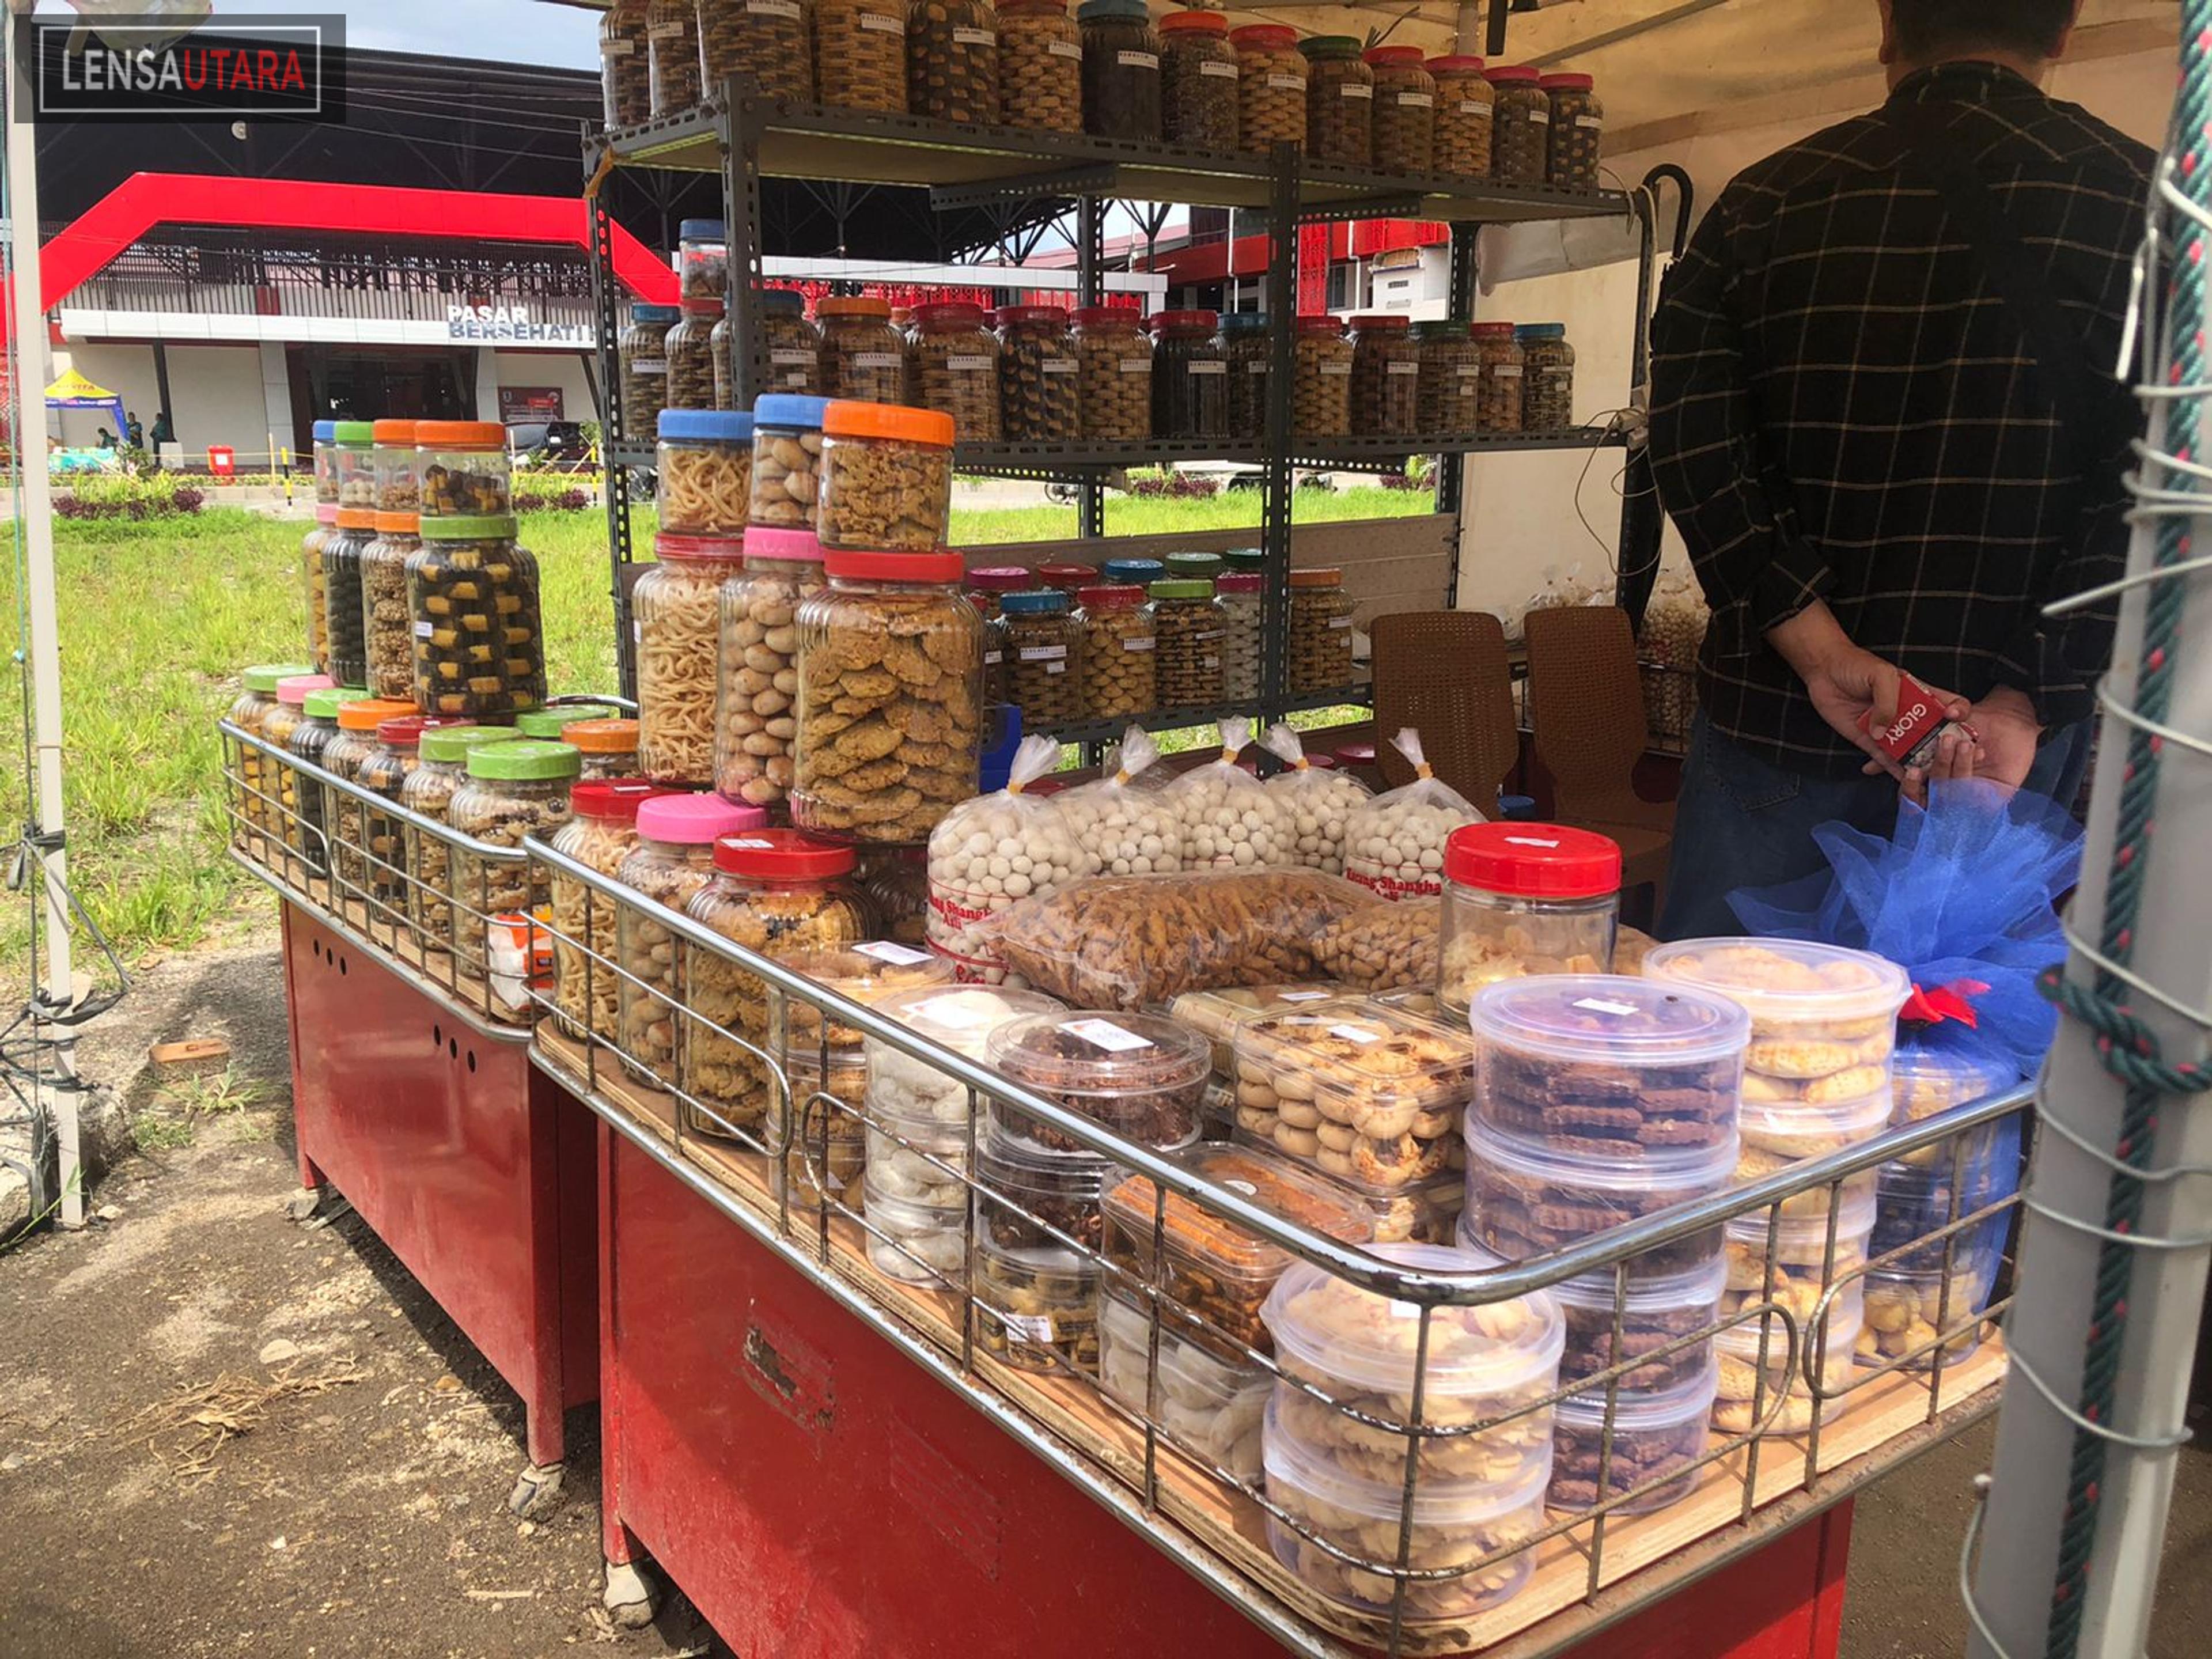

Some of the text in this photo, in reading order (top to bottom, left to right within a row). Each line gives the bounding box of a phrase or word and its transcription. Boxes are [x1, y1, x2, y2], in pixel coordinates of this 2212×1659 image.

[448, 305, 528, 323] PASAR
[1885, 703, 1926, 745] GLORY
[1380, 876, 1441, 895] Shangha
